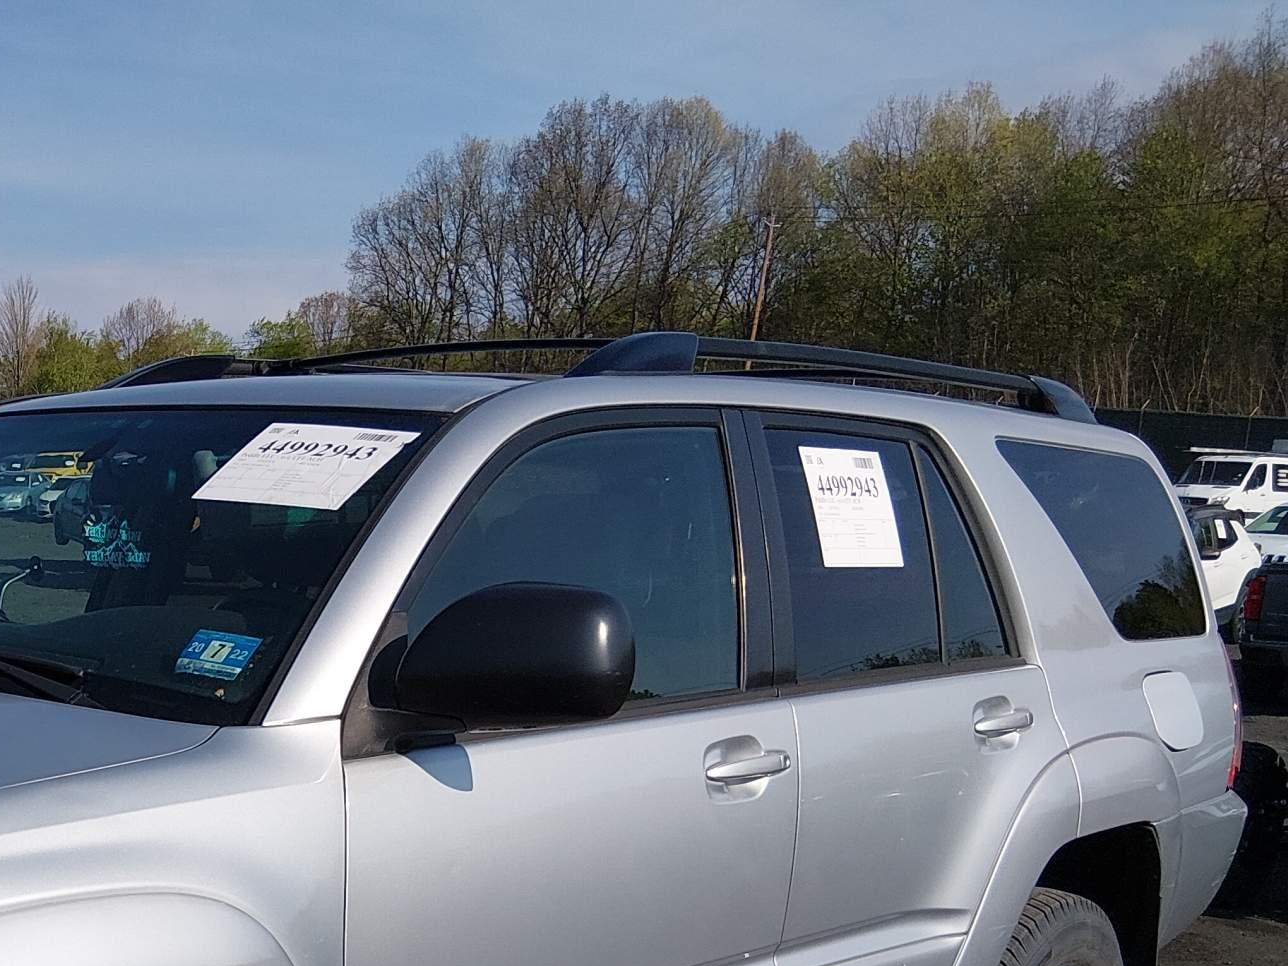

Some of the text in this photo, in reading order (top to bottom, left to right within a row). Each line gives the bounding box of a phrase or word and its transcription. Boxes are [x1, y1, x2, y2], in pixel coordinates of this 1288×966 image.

[258, 440, 378, 460] 44992943
[817, 474, 879, 497] 44992943
[187, 642, 249, 660] 20 7 22
